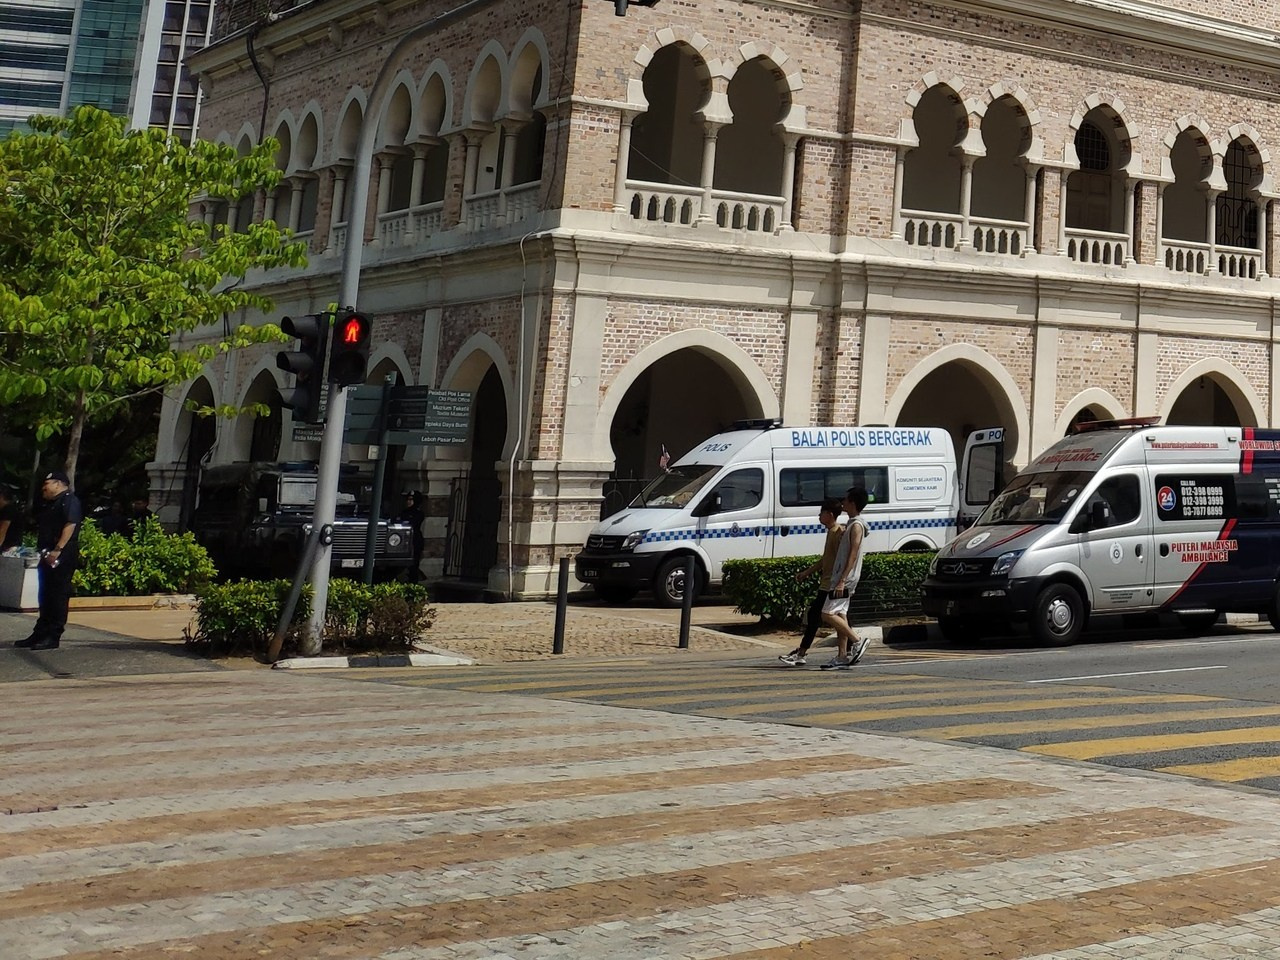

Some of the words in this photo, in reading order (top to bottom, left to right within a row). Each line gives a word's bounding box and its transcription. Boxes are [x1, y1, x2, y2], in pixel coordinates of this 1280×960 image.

[791, 431, 828, 447] BALAI
[831, 430, 865, 447] POLIS
[869, 430, 932, 446] BERGERAK
[699, 443, 732, 453] POLIS
[1238, 440, 1274, 450] WORLDWIDE
[1035, 452, 1103, 465] AMBULANCE
[1161, 492, 1173, 503] 24
[1207, 496, 1224, 505] 3999
[1171, 542, 1199, 552] PUTERI
[1200, 540, 1238, 551] MALAYSIA
[1181, 551, 1229, 562] AMBULANCE
